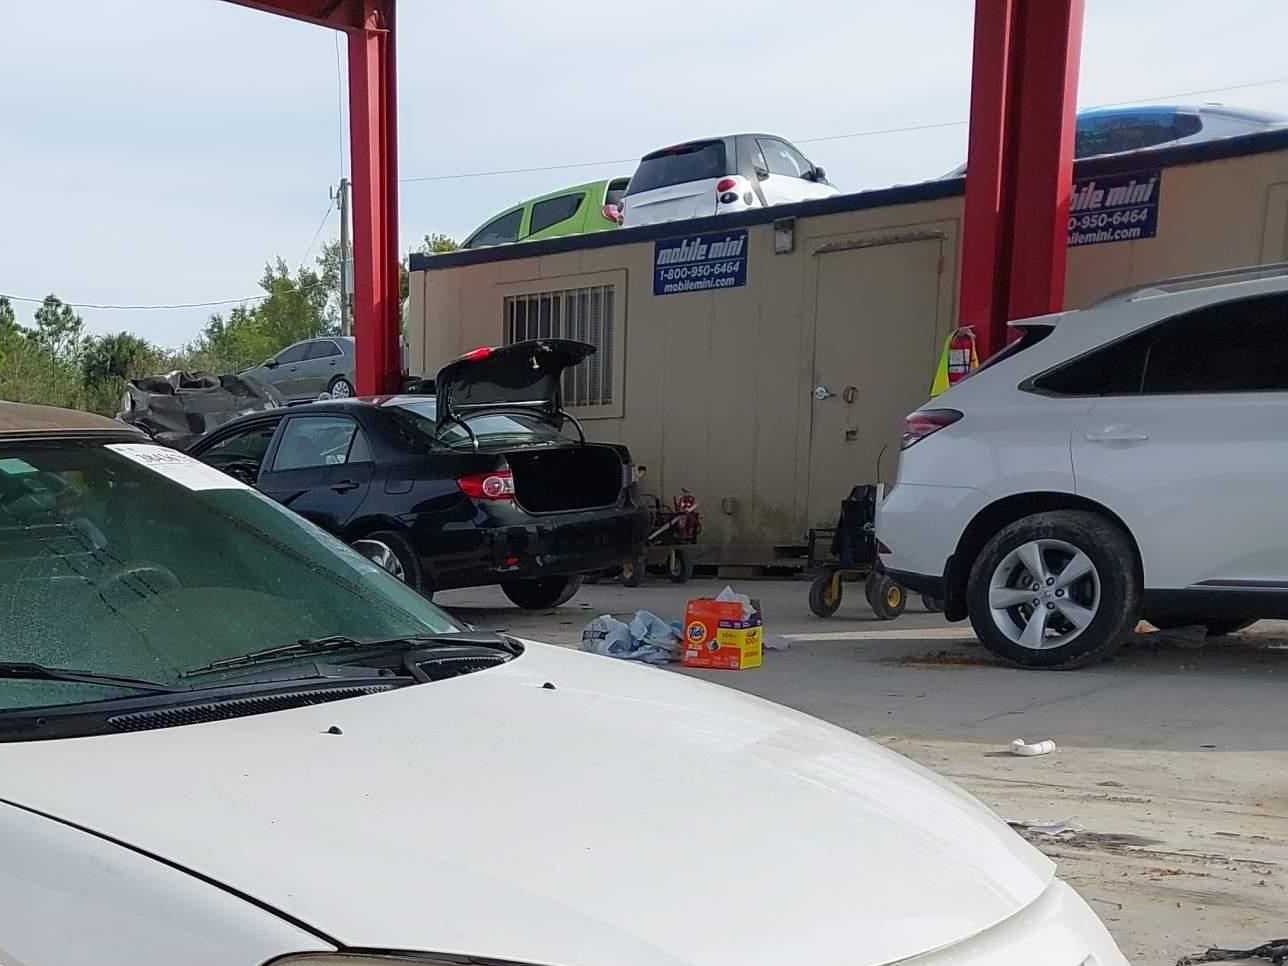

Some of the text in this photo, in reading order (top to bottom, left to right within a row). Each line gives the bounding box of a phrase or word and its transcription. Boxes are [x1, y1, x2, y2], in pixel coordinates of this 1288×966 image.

[1070, 178, 1156, 212] bile mini
[1068, 208, 1148, 230] 0-950-6464
[1067, 227, 1141, 244] ilemini.com
[657, 235, 745, 264] mobile mini
[660, 261, 740, 281] 1-800-950-6464
[664, 276, 735, 293] mobilemini.com
[688, 626, 705, 637] Tide
